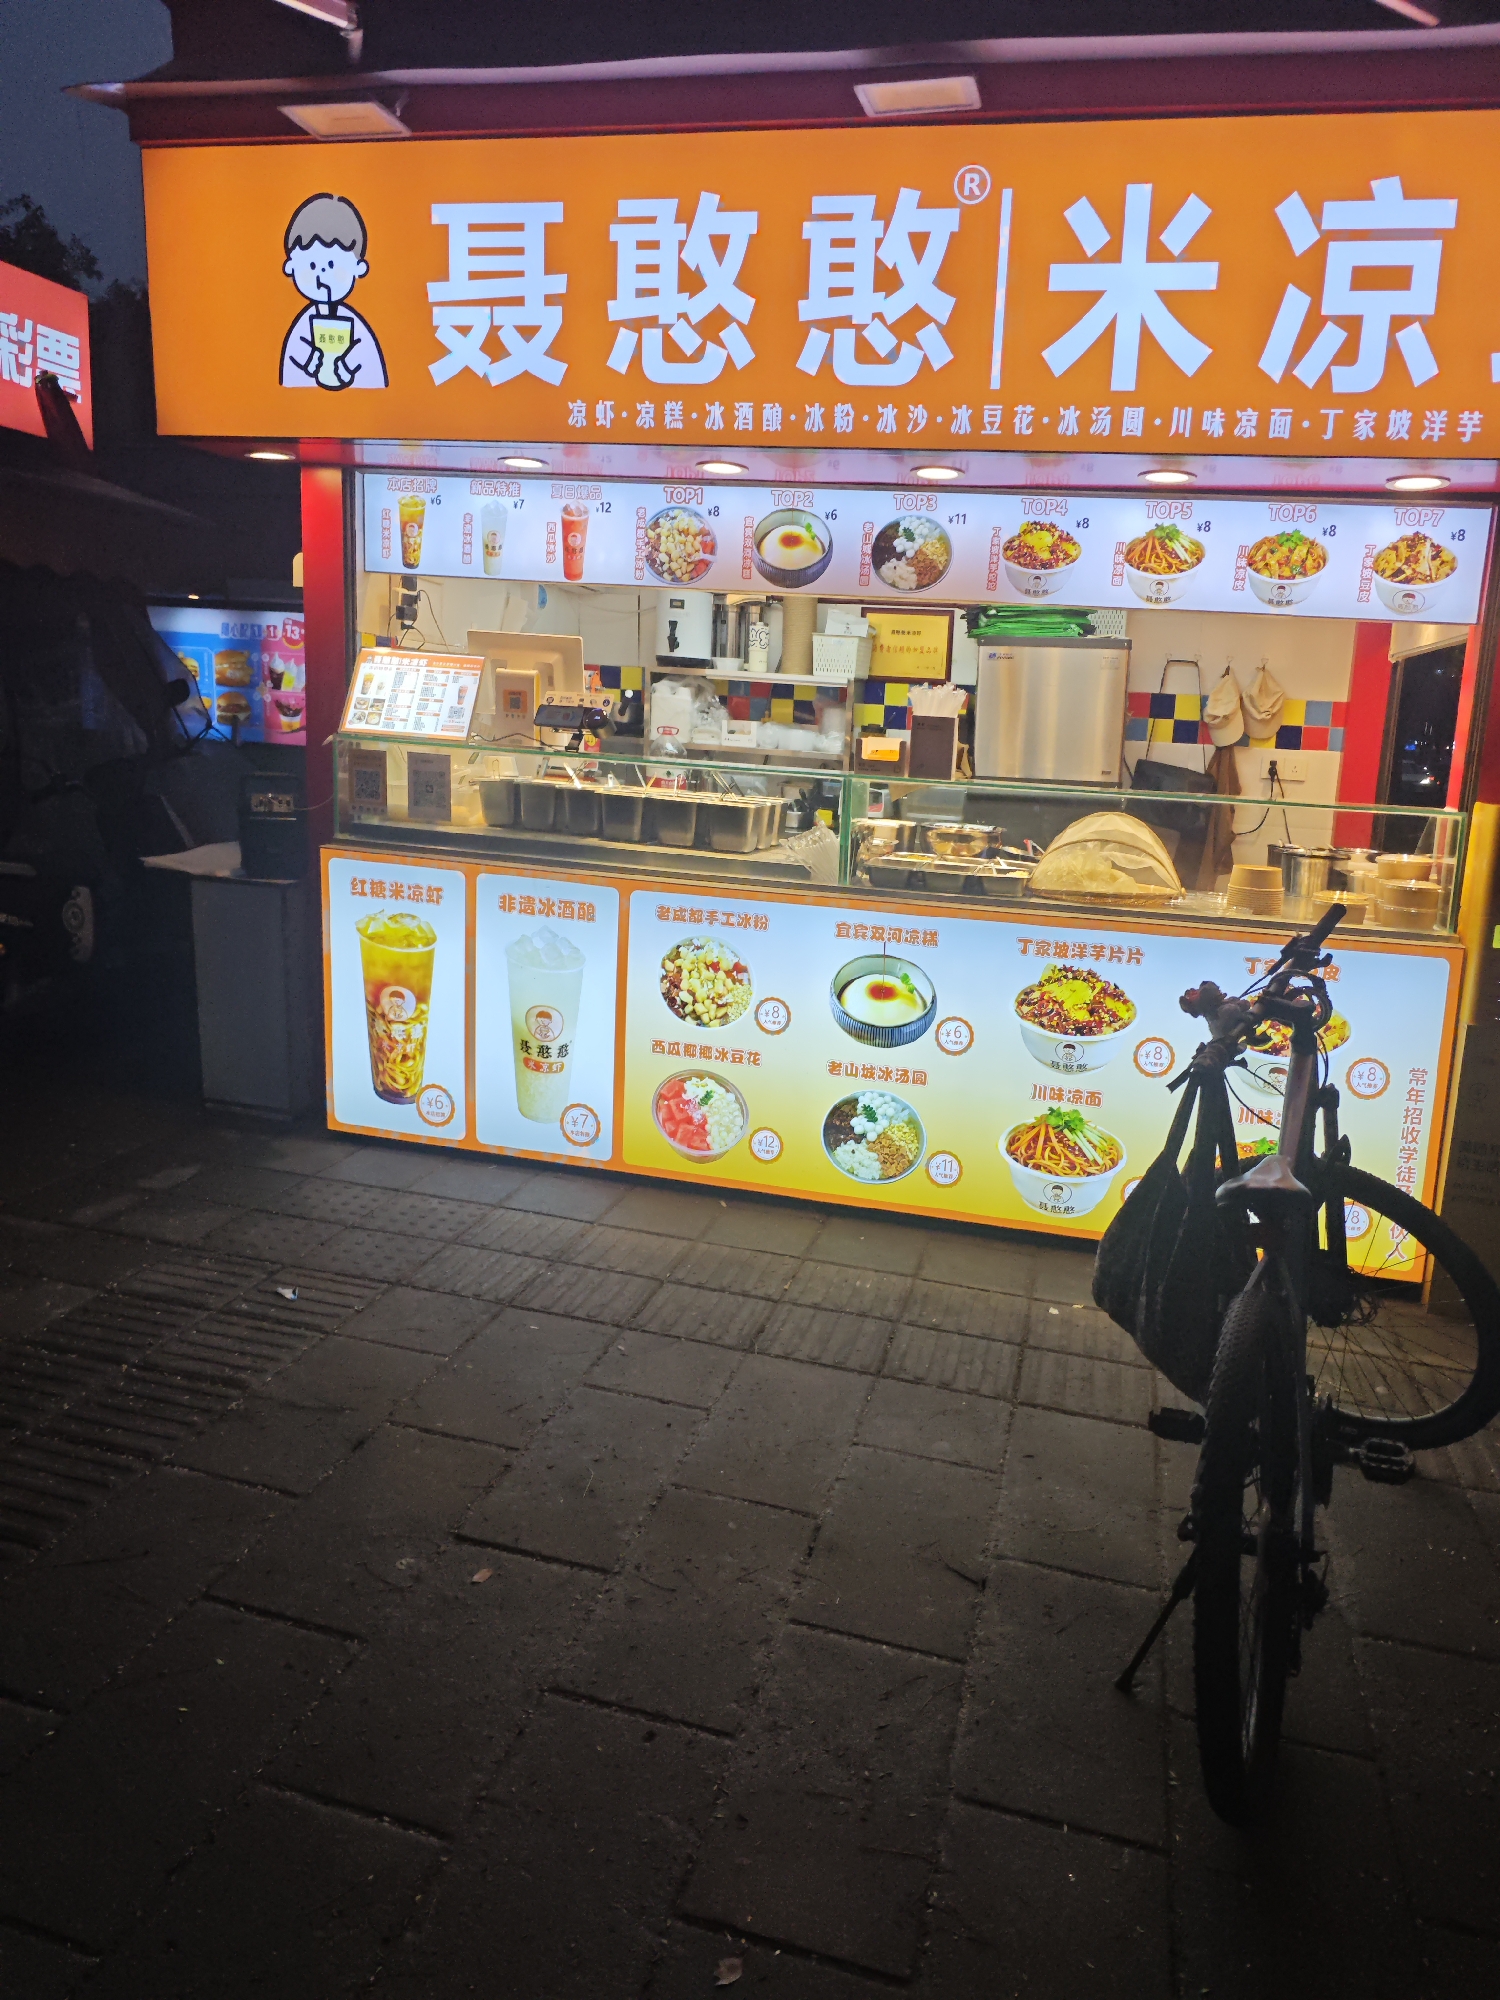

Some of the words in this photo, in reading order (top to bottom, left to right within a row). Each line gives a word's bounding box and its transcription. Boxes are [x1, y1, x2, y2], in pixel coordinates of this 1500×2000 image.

[426, 188, 961, 387] 聂憨憨
[1041, 176, 1500, 393] 米凉
[0, 312, 82, 404] 彩票
[387, 477, 437, 494] 本店招牌
[470, 479, 521, 497] 新品特推
[551, 483, 602, 500] 夏日爆品
[430, 495, 441, 506] ¥6
[513, 499, 525, 510] ¥7
[663, 486, 704, 505] TOP1
[771, 490, 814, 508] TOP2
[893, 493, 938, 512] TOP3
[595, 501, 612, 513] ¥12
[707, 506, 720, 517] ¥8
[825, 509, 838, 521] ¥6
[1021, 498, 1068, 516] TOP4
[1145, 501, 1193, 519] TOP5
[1268, 504, 1317, 523] TOP6
[948, 513, 967, 525] ¥11
[1076, 517, 1090, 529] ¥8
[1196, 520, 1211, 532] ¥8
[1394, 507, 1445, 527] TOP7
[1322, 525, 1337, 537] ¥8
[1450, 529, 1466, 541] ¥8
[1111, 541, 1127, 586] 川味凉面
[1357, 544, 1377, 602] 丁家坡豆皮
[350, 876, 444, 906] 红糖米凉虾
[498, 893, 596, 923] 非遗冰酒酿
[655, 904, 769, 931] 老成都手工冰粉
[835, 921, 939, 947] 宜宾双河凉糕
[1016, 937, 1145, 965] 丁家坡洋芋片片
[764, 1005, 780, 1019] ¥8
[945, 1025, 962, 1039] ¥6
[1144, 1046, 1163, 1060] ¥8
[827, 1060, 928, 1087] 老山城冰汤圆
[1357, 1067, 1377, 1082] ¥8
[427, 1095, 444, 1110] ¥6
[1031, 1083, 1103, 1108] 川味凉面
[571, 1113, 589, 1129] ¥7
[1238, 1106, 1282, 1126] 川味
[757, 1135, 775, 1148] ¥12
[935, 1158, 954, 1173] ¥11
[1386, 1066, 1429, 1261] 常年招收学徒及伙人
